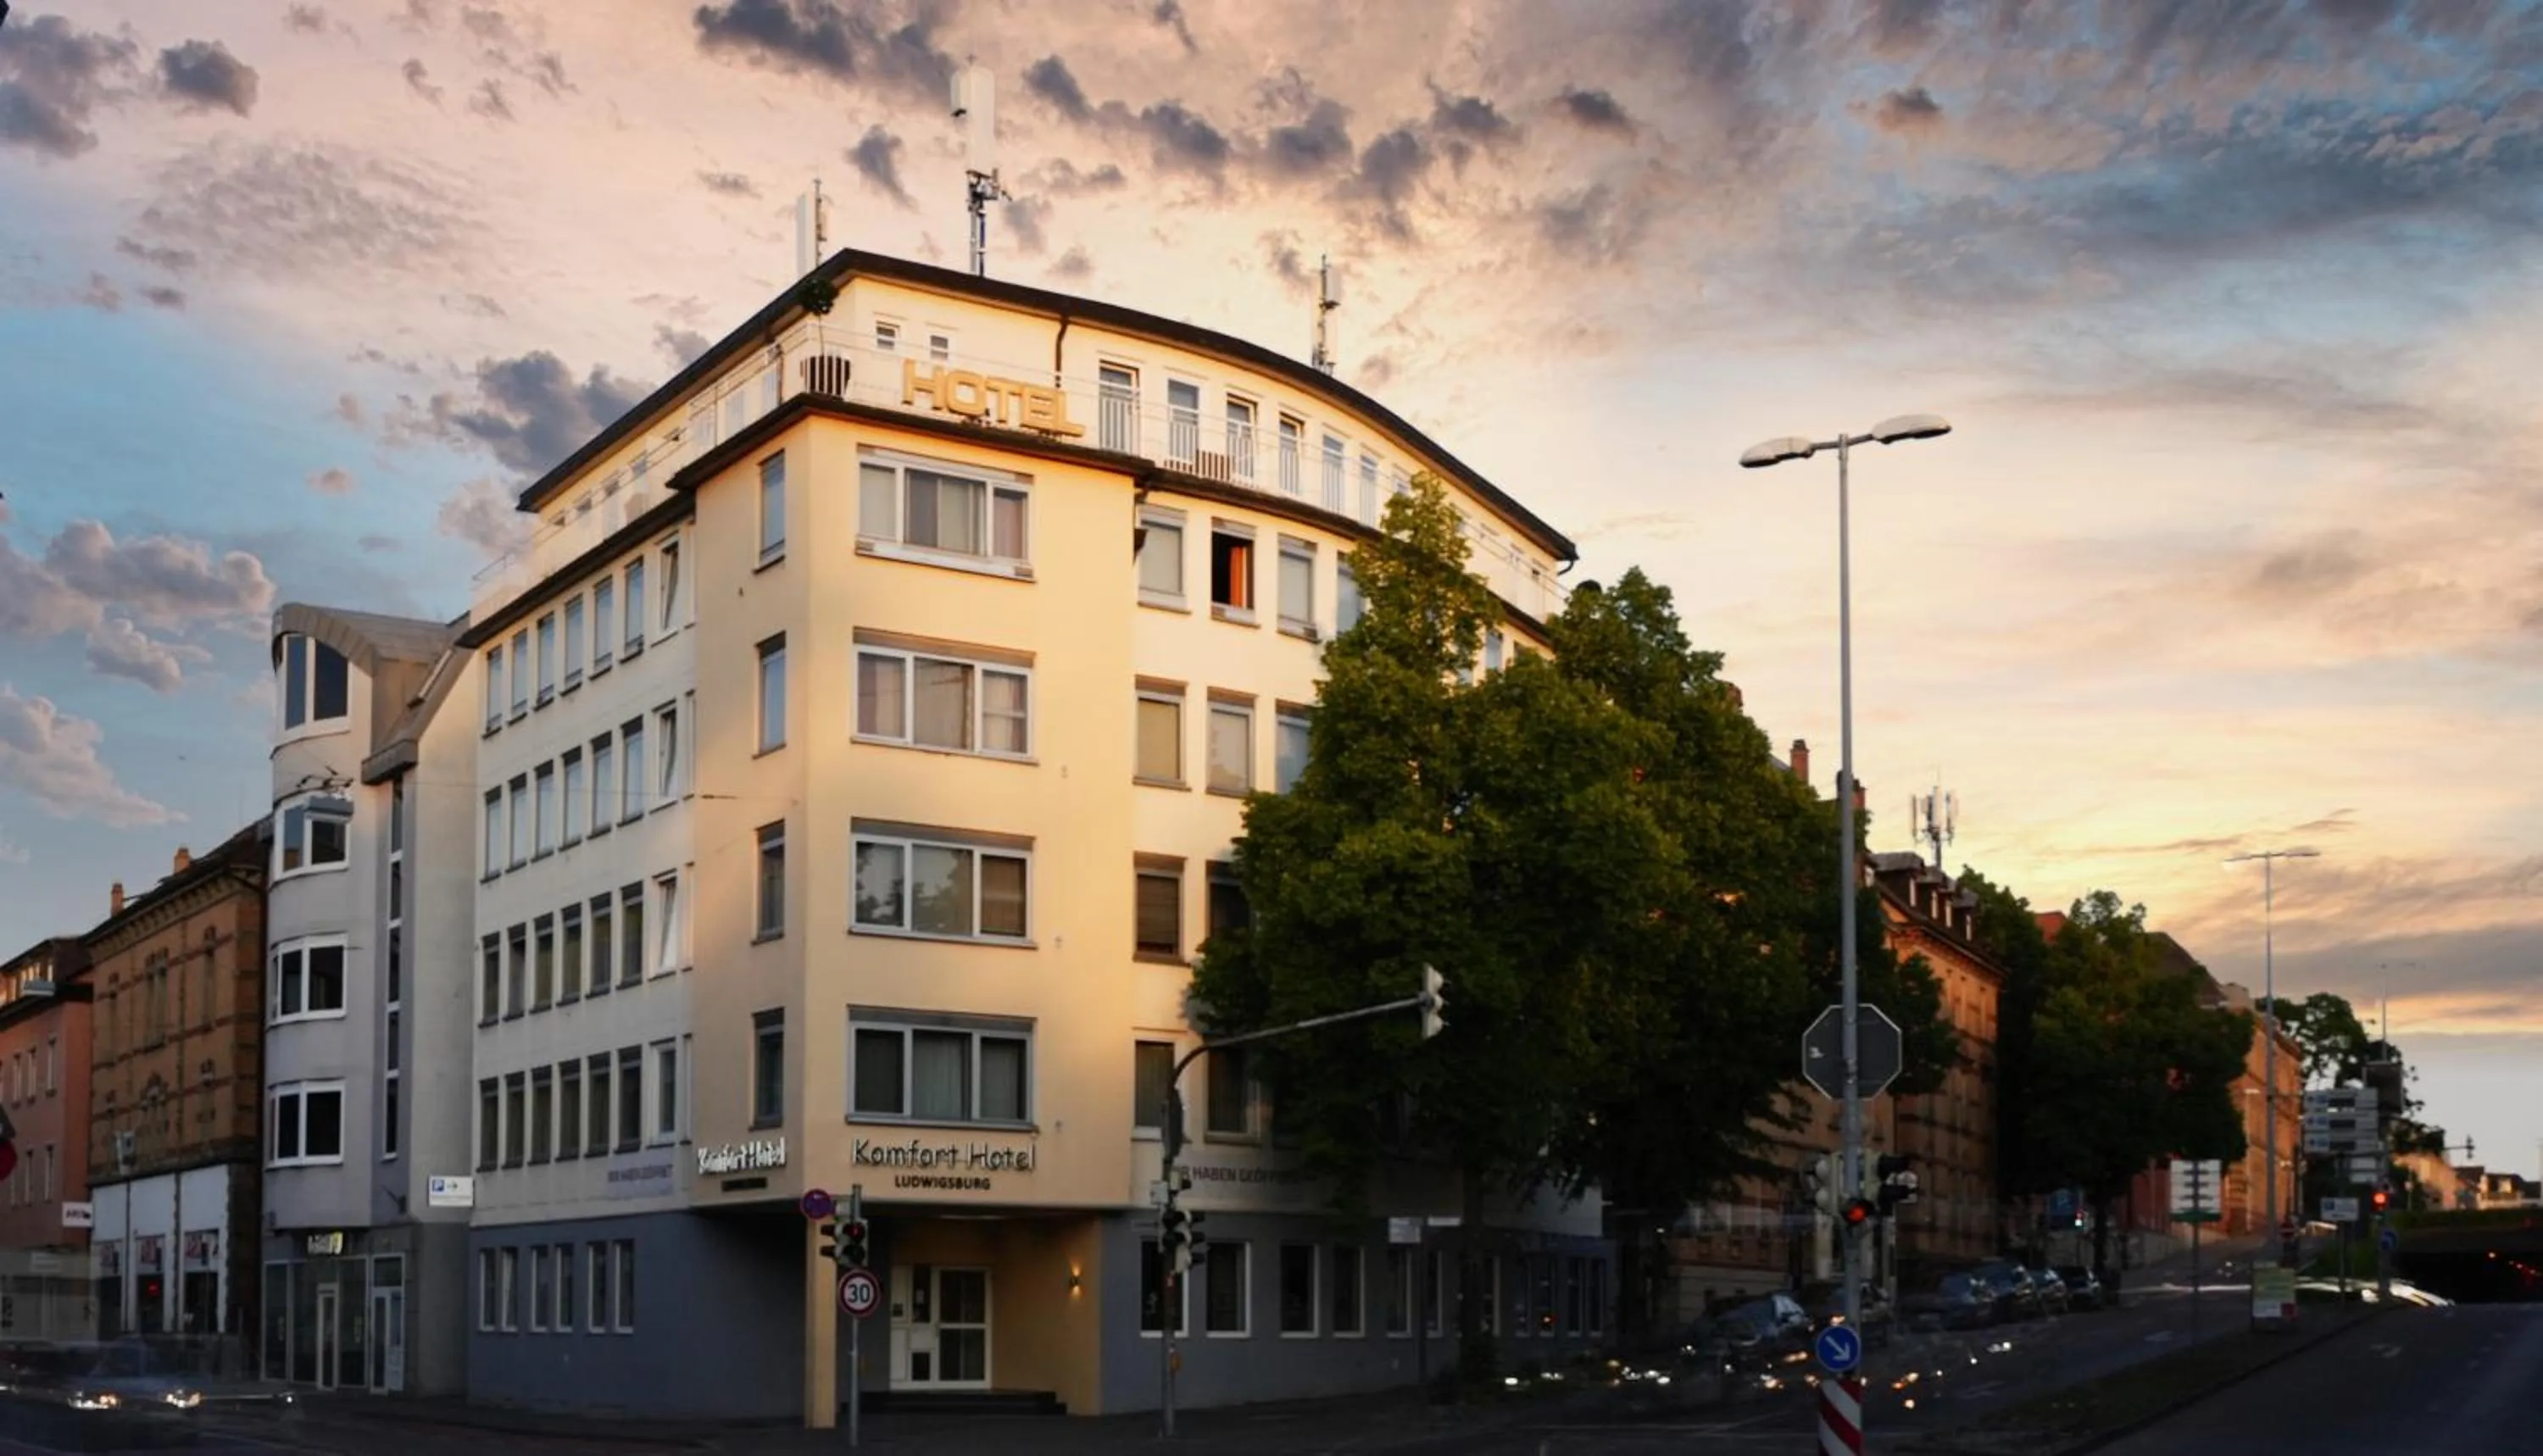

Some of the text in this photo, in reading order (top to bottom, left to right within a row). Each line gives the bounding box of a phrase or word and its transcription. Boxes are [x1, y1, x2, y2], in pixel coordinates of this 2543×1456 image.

[902, 358, 1086, 437] HOTEL
[853, 1138, 1036, 1171] Komfort Hotel
[894, 1175, 991, 1190] LUDWIGSBURG
[1192, 1167, 1236, 1181] HABEN
[848, 1283, 870, 1303] 30
